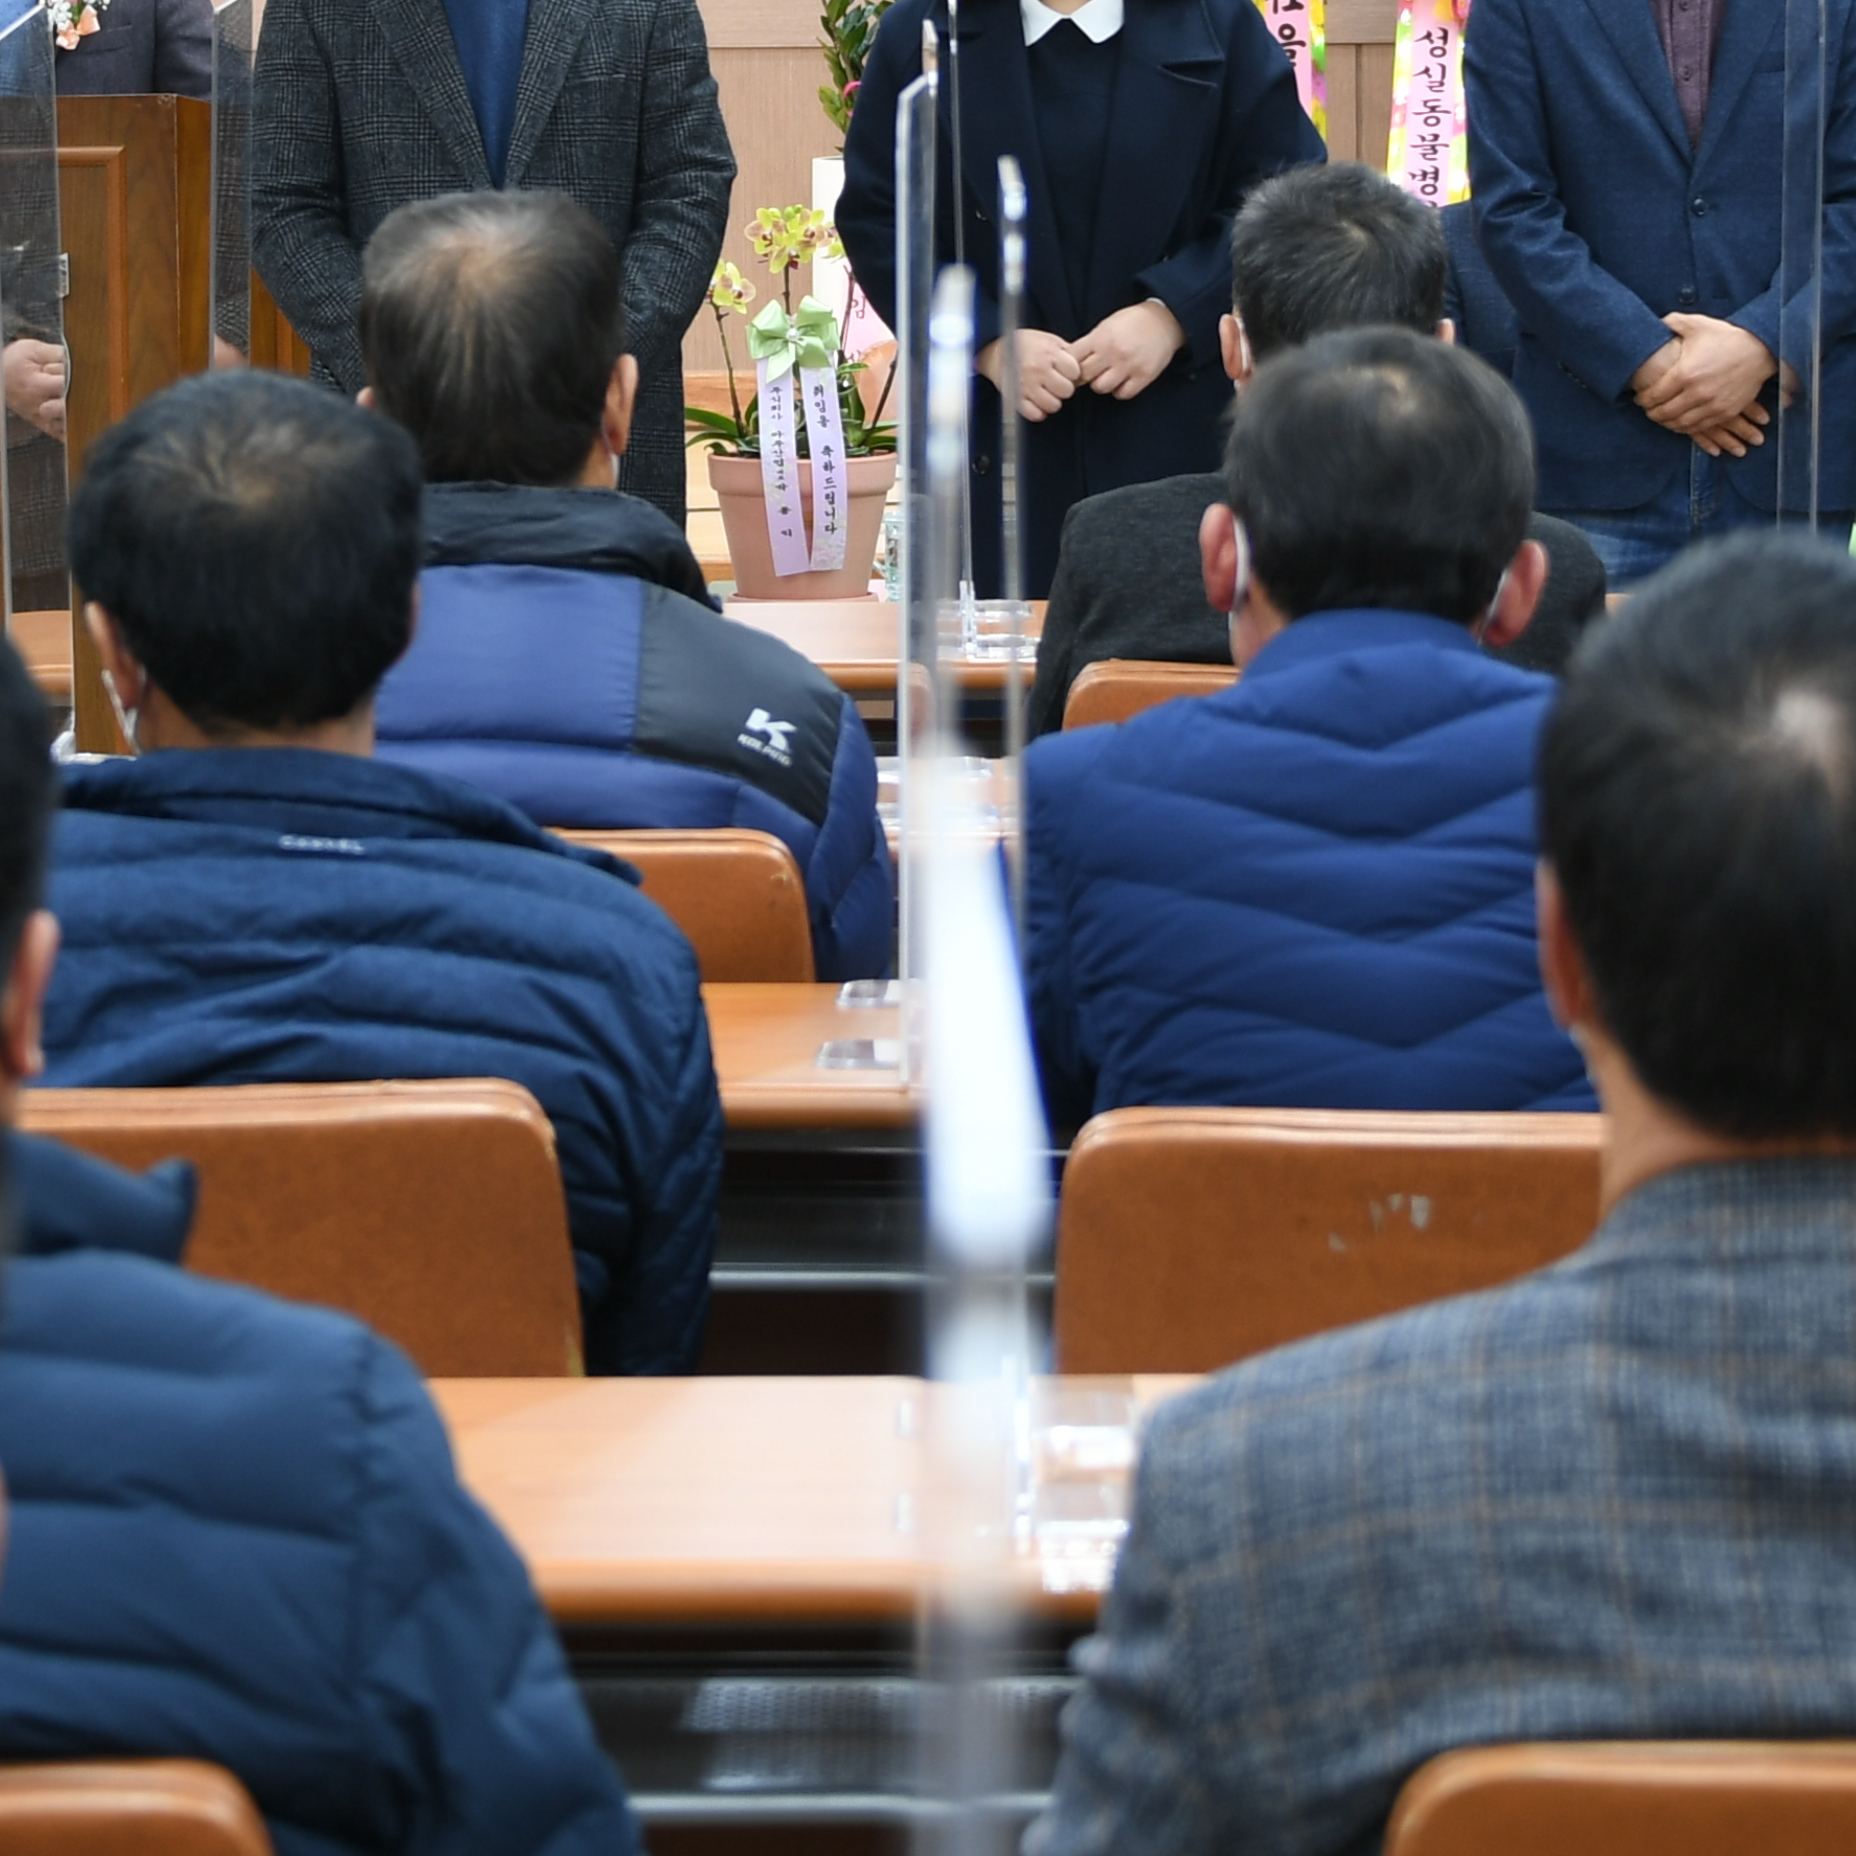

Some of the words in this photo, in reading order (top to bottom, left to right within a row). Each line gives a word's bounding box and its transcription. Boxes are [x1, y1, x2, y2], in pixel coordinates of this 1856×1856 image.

[1407, 26, 1453, 208] 성실동물병
[812, 384, 831, 429] 취임을
[819, 445, 839, 536] 축하드립니다
